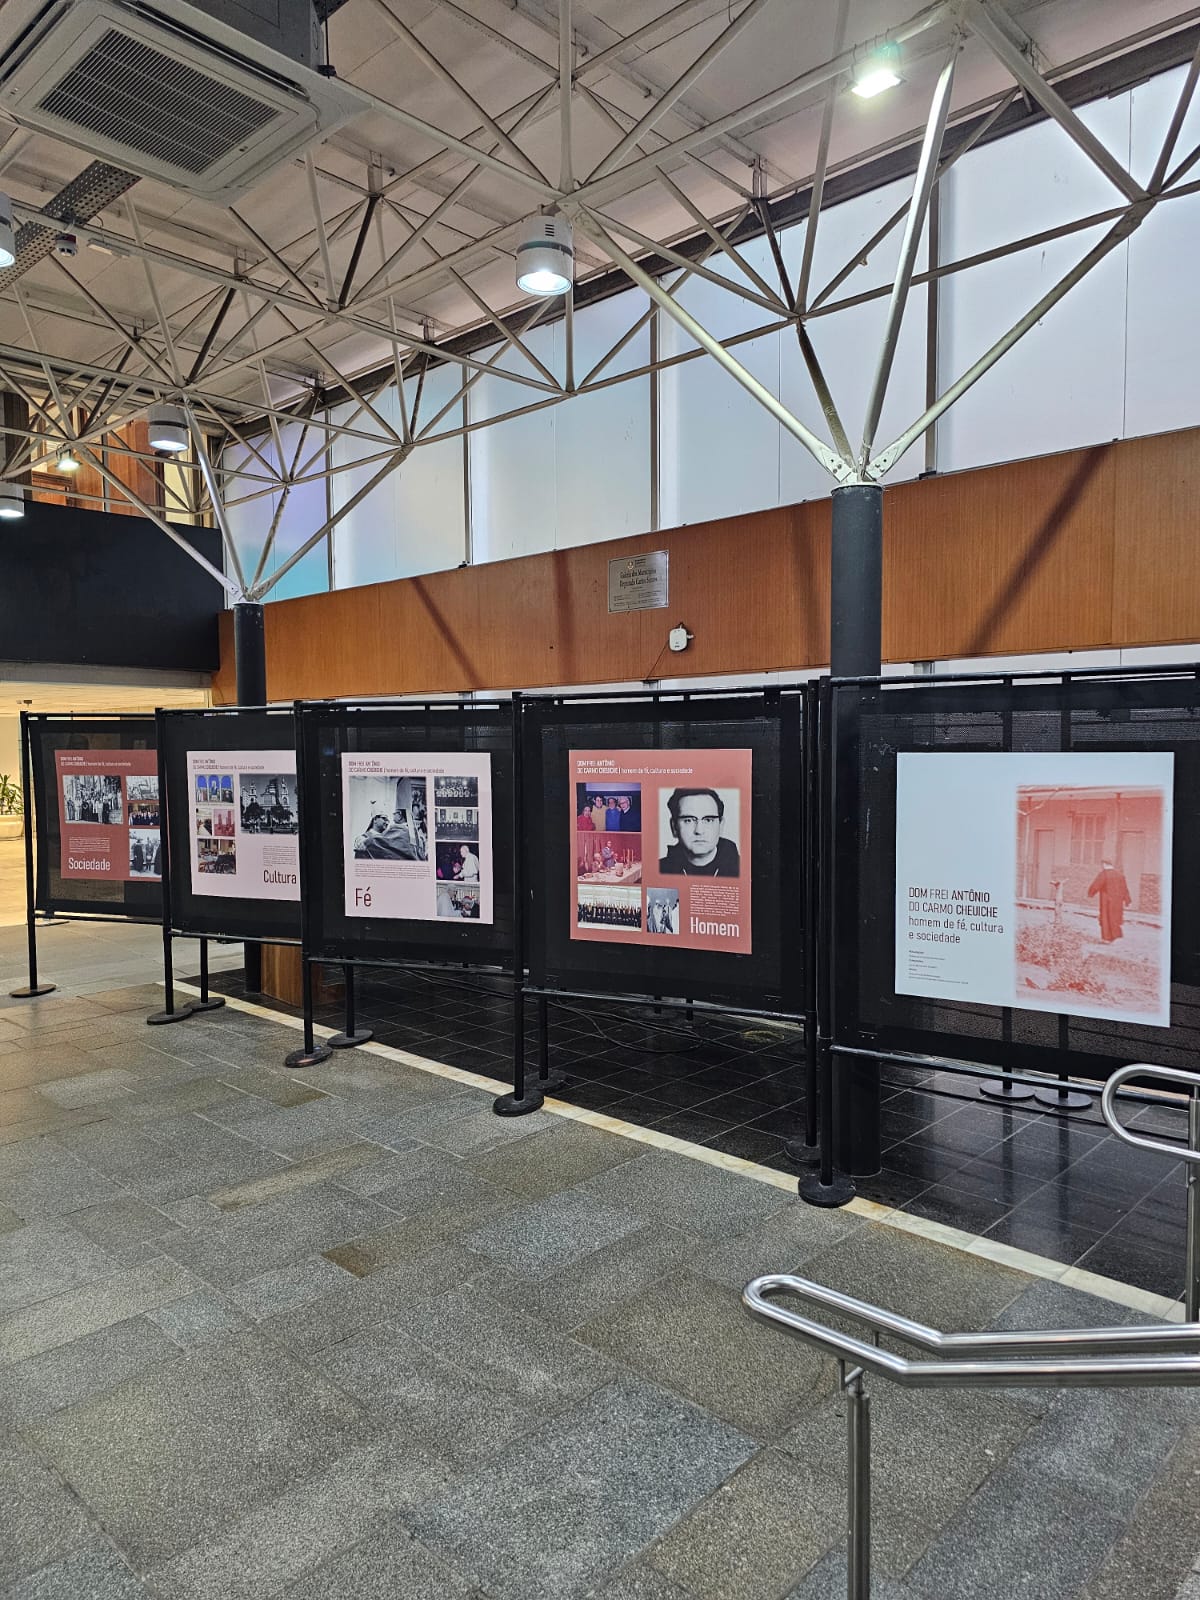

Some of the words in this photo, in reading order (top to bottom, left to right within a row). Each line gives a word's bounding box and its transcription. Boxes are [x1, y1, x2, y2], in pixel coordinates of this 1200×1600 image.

[69, 857, 111, 871] Sociedade
[263, 869, 297, 884] Cultura
[355, 886, 372, 907] Fé
[908, 887, 928, 899] DOM
[929, 888, 949, 900] FREI
[951, 888, 990, 903] ANTÔNIO
[908, 901, 920, 912] DO
[922, 901, 953, 915] CARMO
[956, 904, 998, 918] CHEUICHE
[690, 917, 740, 938] Homem
[908, 916, 941, 928] homem
[943, 918, 954, 929] de
[957, 918, 968, 931] fé,
[970, 921, 1004, 934] cultura
[908, 931, 914, 940] e
[916, 931, 961, 944] sociedade
